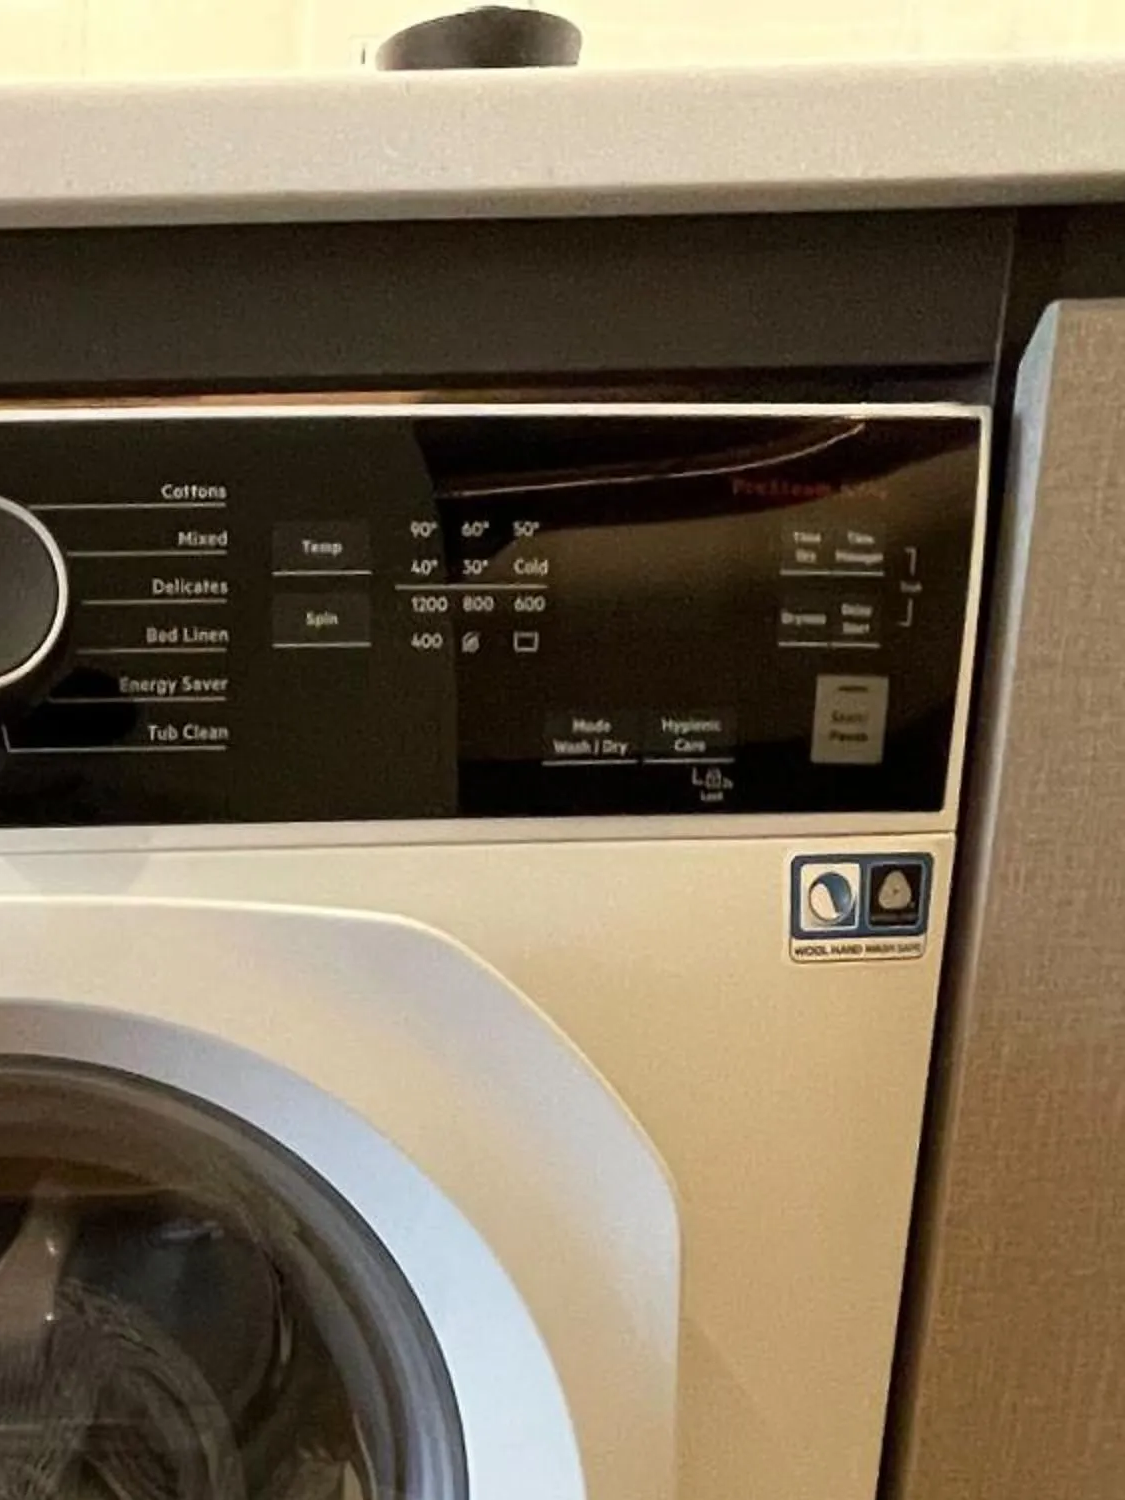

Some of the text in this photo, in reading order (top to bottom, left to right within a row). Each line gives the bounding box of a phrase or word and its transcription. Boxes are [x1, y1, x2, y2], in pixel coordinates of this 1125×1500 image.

[161, 484, 227, 499] Cottons
[178, 530, 228, 546] Mixed
[302, 540, 343, 556] Temp
[513, 557, 549, 576] Cold
[152, 578, 228, 594] Delicates
[411, 596, 448, 612] 1200
[462, 596, 494, 612] 800
[513, 596, 546, 612] 600
[305, 612, 339, 630] Spin
[146, 627, 229, 643] Bed Linen
[411, 632, 443, 649] 400
[119, 676, 228, 695] Energy Saver
[148, 723, 228, 740] Tub Clean
[572, 717, 612, 733] Mode
[553, 738, 629, 756] Wash Dry
